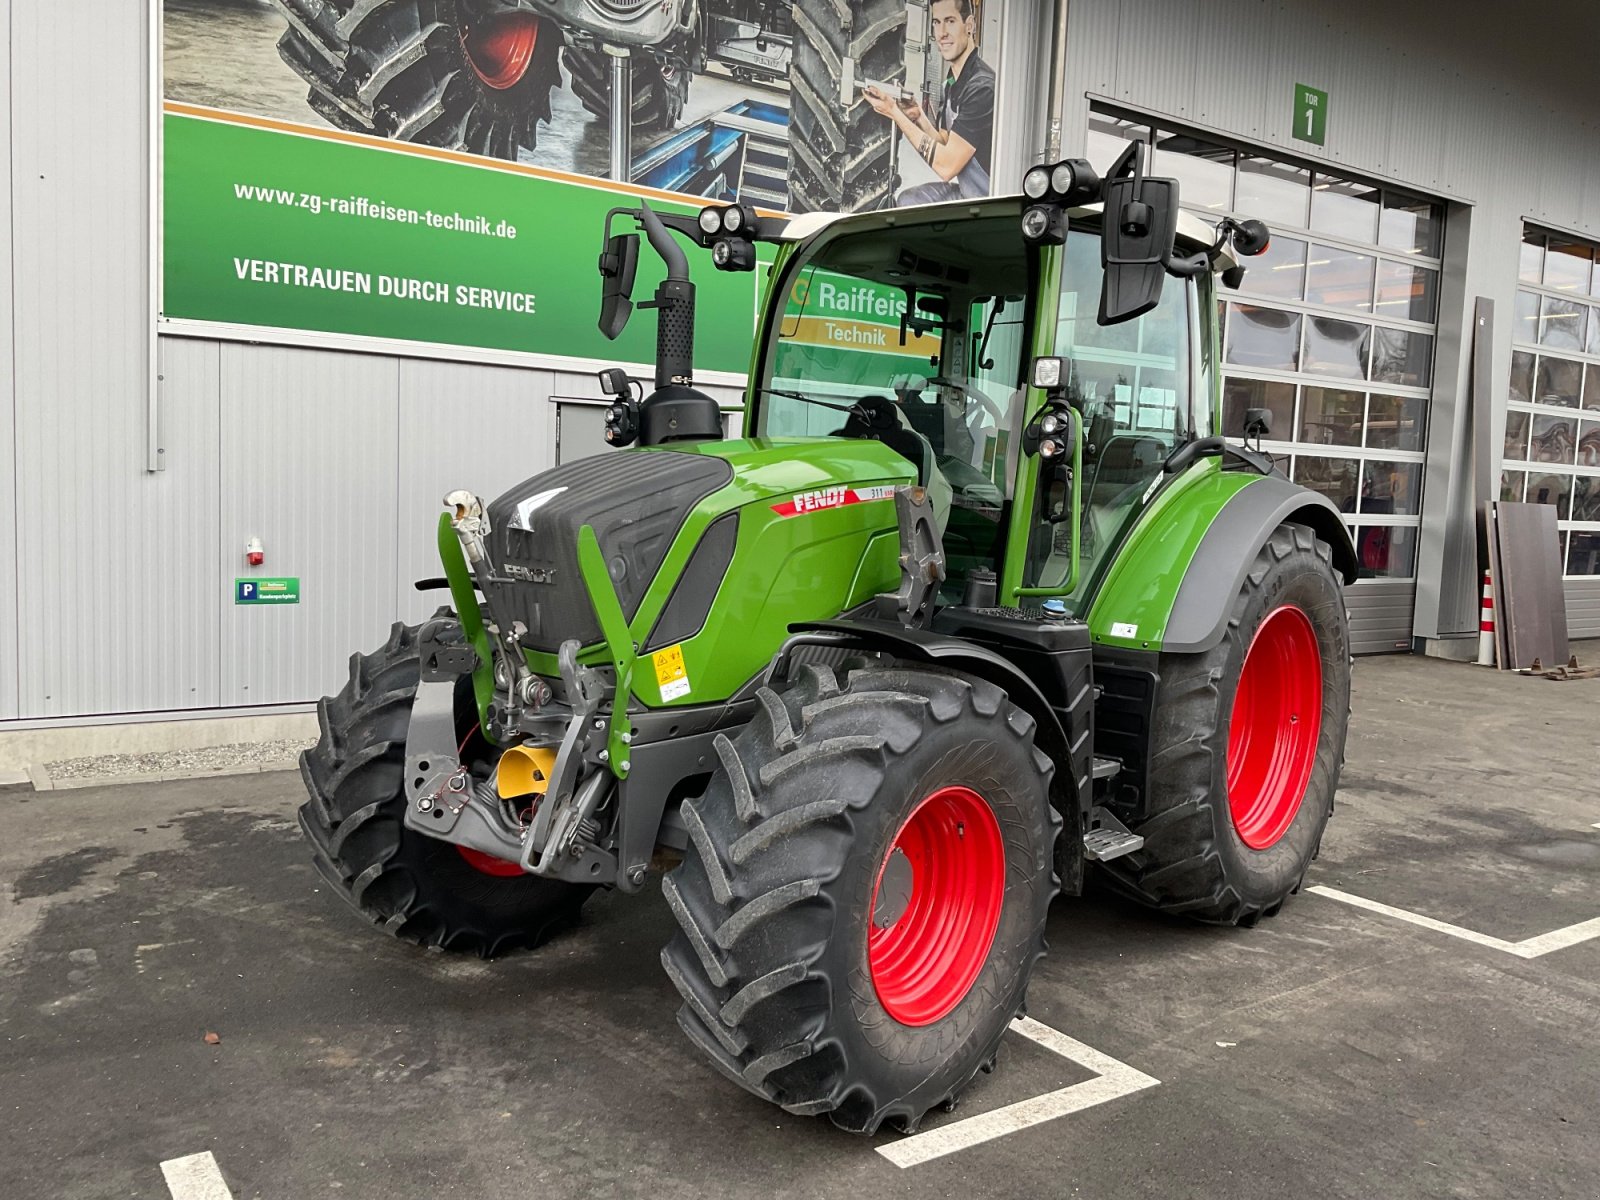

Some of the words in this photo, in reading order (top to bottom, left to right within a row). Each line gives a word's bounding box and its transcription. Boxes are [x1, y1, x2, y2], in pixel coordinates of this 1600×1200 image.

[1304, 92, 1318, 106] TOR
[1305, 109, 1313, 136] 1
[234, 183, 517, 239] www.zg-raiffeisen-technik.de
[233, 257, 371, 294] VERTRAUEN
[378, 275, 449, 303] DURCH
[455, 285, 536, 314] SERVICE
[791, 278, 810, 305] G
[825, 322, 886, 346] Technik
[793, 485, 848, 512] FENDT
[871, 488, 883, 499] 311
[243, 583, 253, 597] P
